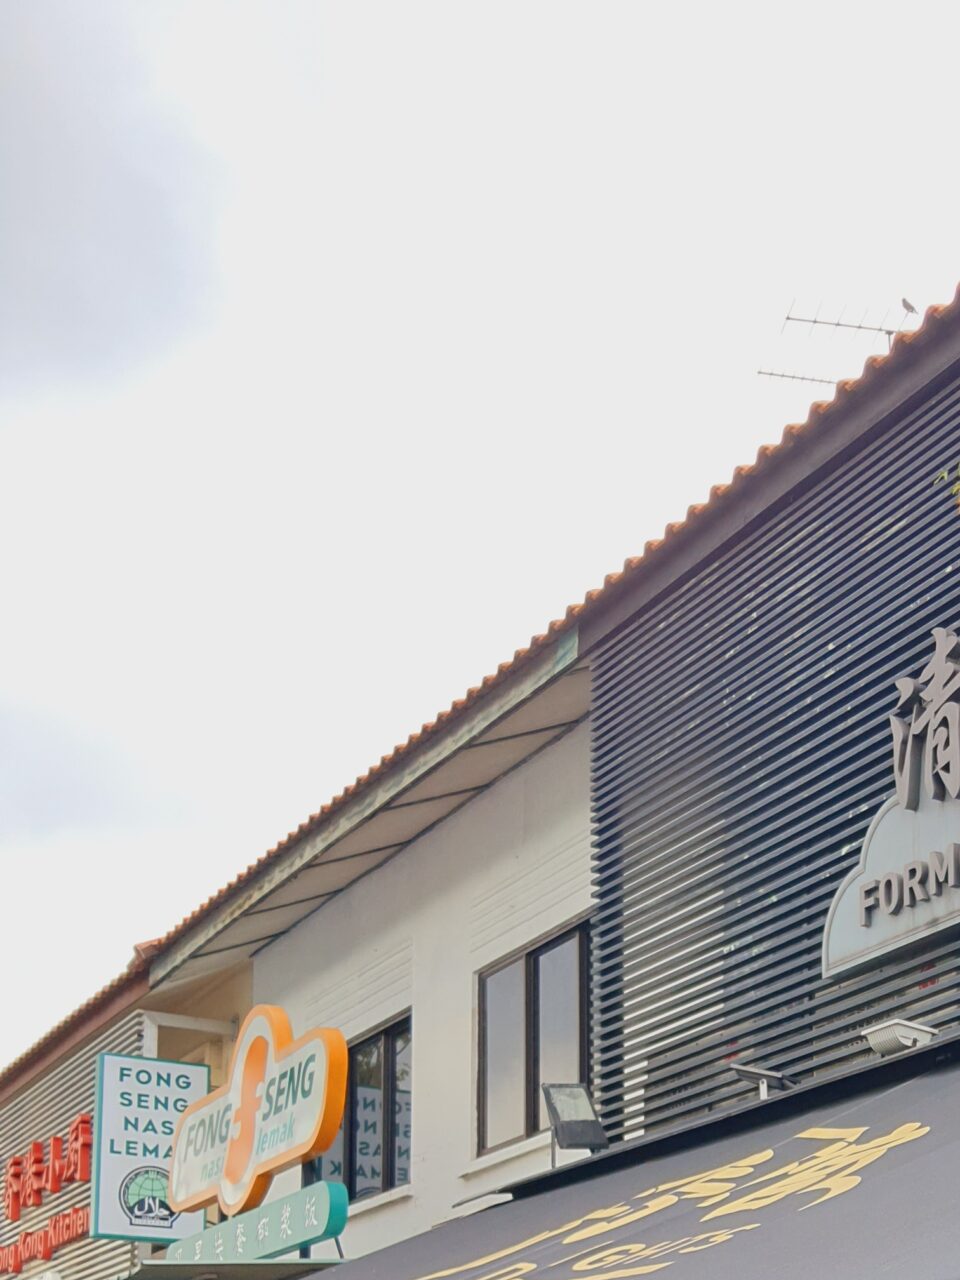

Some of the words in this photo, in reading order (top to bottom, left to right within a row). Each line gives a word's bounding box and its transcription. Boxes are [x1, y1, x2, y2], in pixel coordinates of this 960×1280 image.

[119, 1067, 191, 1089] FONG
[120, 1092, 189, 1113] SENG
[184, 1104, 232, 1162] FONG
[262, 1053, 315, 1121] SENG
[124, 1116, 174, 1135] NAS
[255, 1112, 295, 1155] lemak
[110, 1139, 173, 1159] LEMA
[18, 1232, 46, 1261] Kong
[48, 1207, 90, 1248] Kitchen
